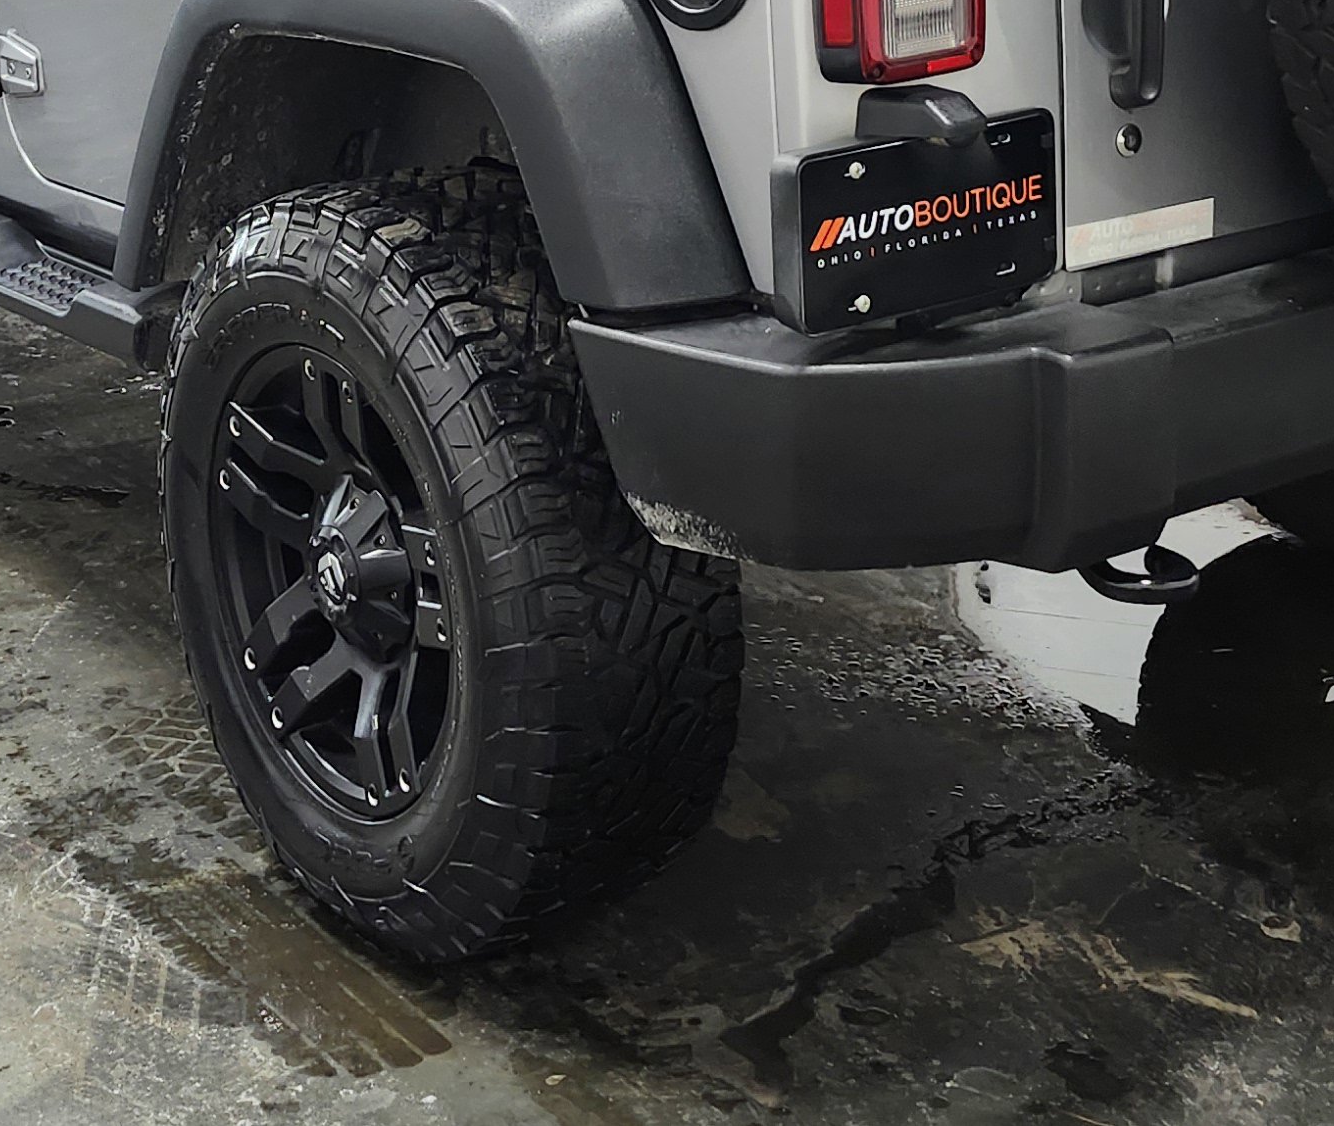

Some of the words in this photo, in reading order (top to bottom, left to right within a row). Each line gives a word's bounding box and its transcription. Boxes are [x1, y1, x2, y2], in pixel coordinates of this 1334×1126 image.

[817, 250, 862, 269] OHIO
[884, 229, 962, 254] FLORIDA
[986, 210, 1037, 230] TEXAS
[836, 174, 1043, 245] AUTOBOUTIQUE
